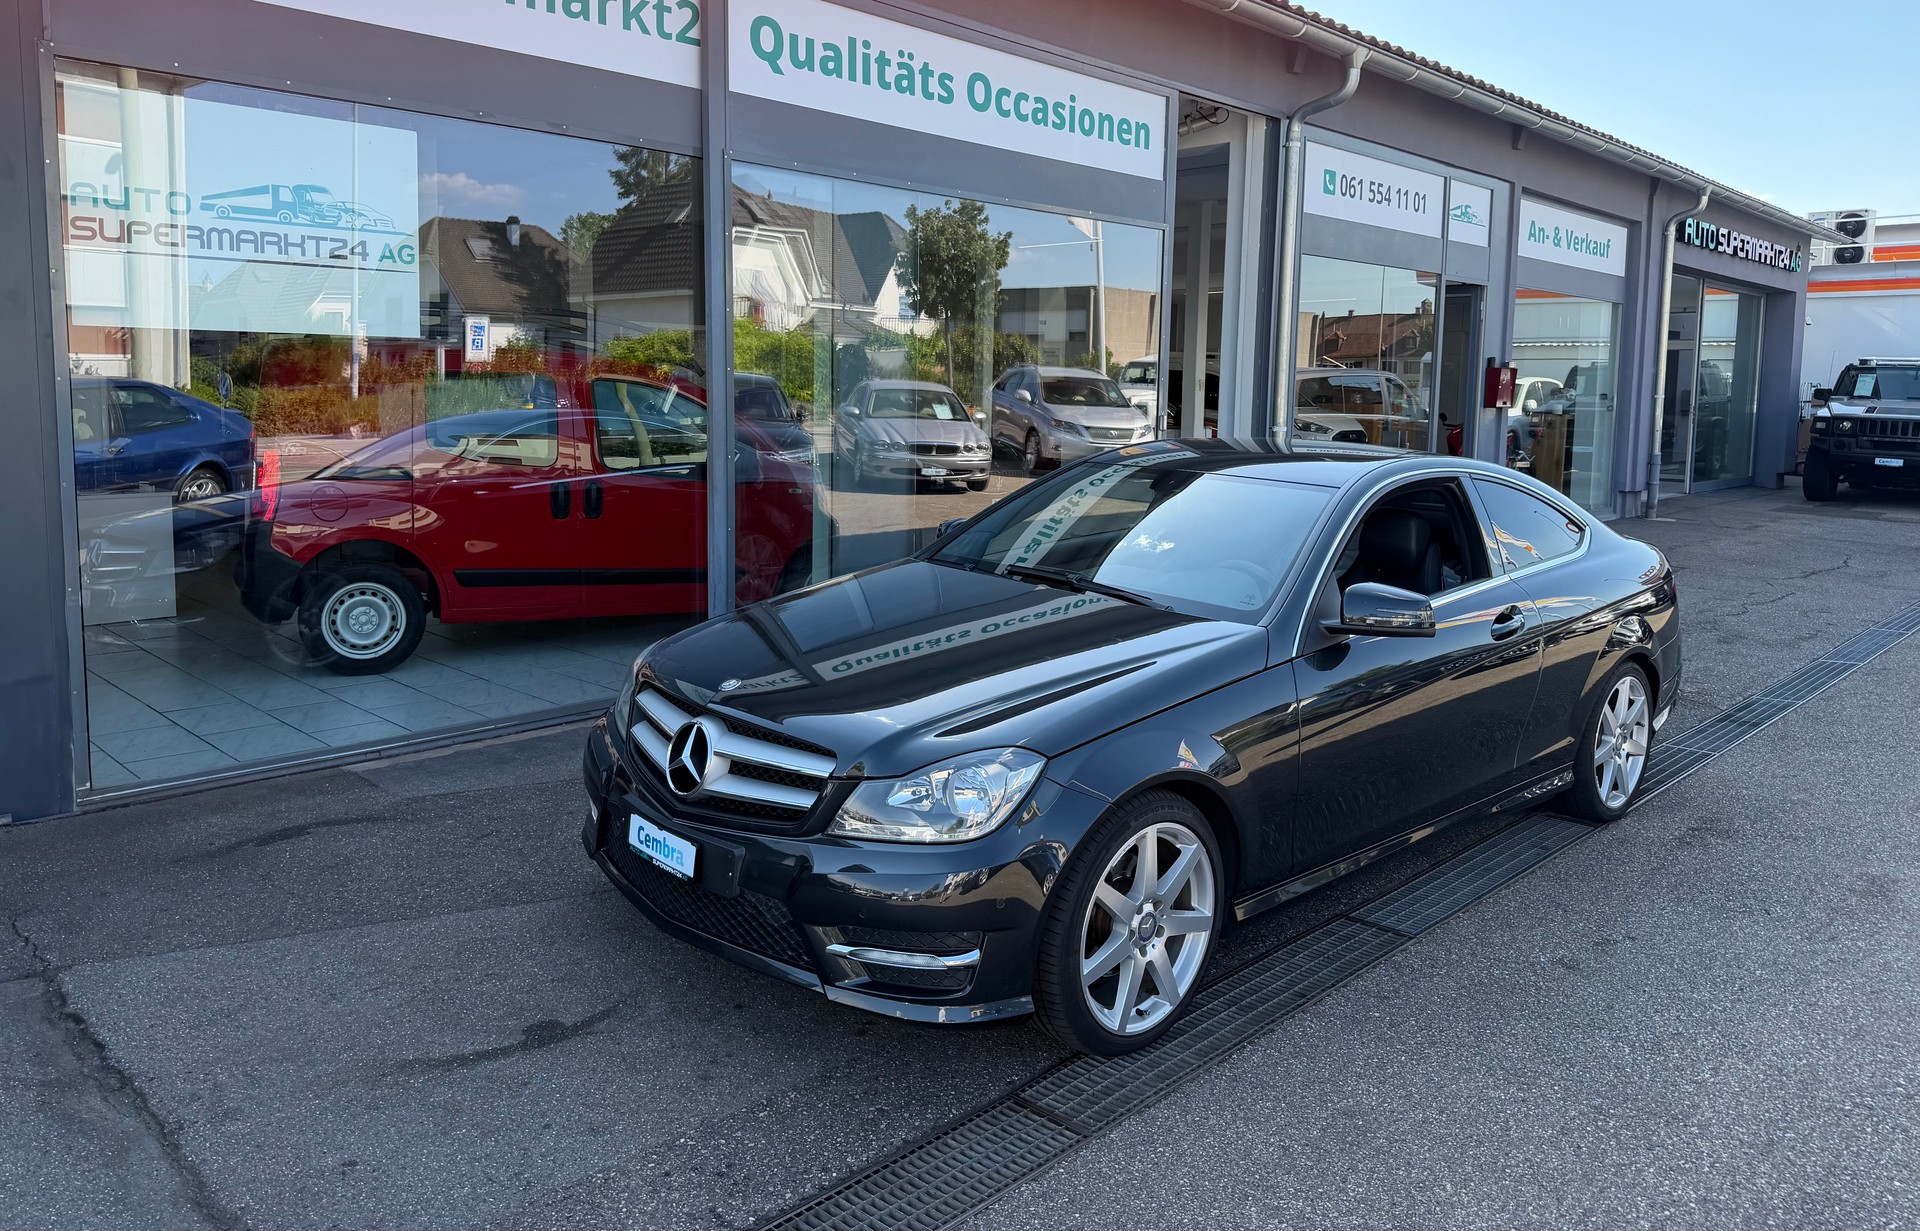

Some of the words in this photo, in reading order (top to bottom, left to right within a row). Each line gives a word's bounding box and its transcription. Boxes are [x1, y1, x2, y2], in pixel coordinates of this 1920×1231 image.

[750, 15, 955, 106] Qualitäts
[966, 72, 1151, 150] Occasionen
[70, 181, 192, 216] AUTO
[1340, 173, 1364, 201] 061
[1368, 180, 1392, 207] 554
[1396, 187, 1409, 211] 11
[1413, 191, 1427, 215] 01
[70, 216, 369, 262] SUPERMARKT24
[377, 243, 416, 265] AG
[1528, 220, 1549, 244] An-
[1552, 226, 1562, 248] &
[1565, 228, 1611, 259] Verkauf
[1684, 217, 1717, 250] AUTO
[1718, 227, 1790, 270] SUPERMARKT24
[1790, 250, 1802, 273] AG
[637, 825, 685, 867] Cembra
